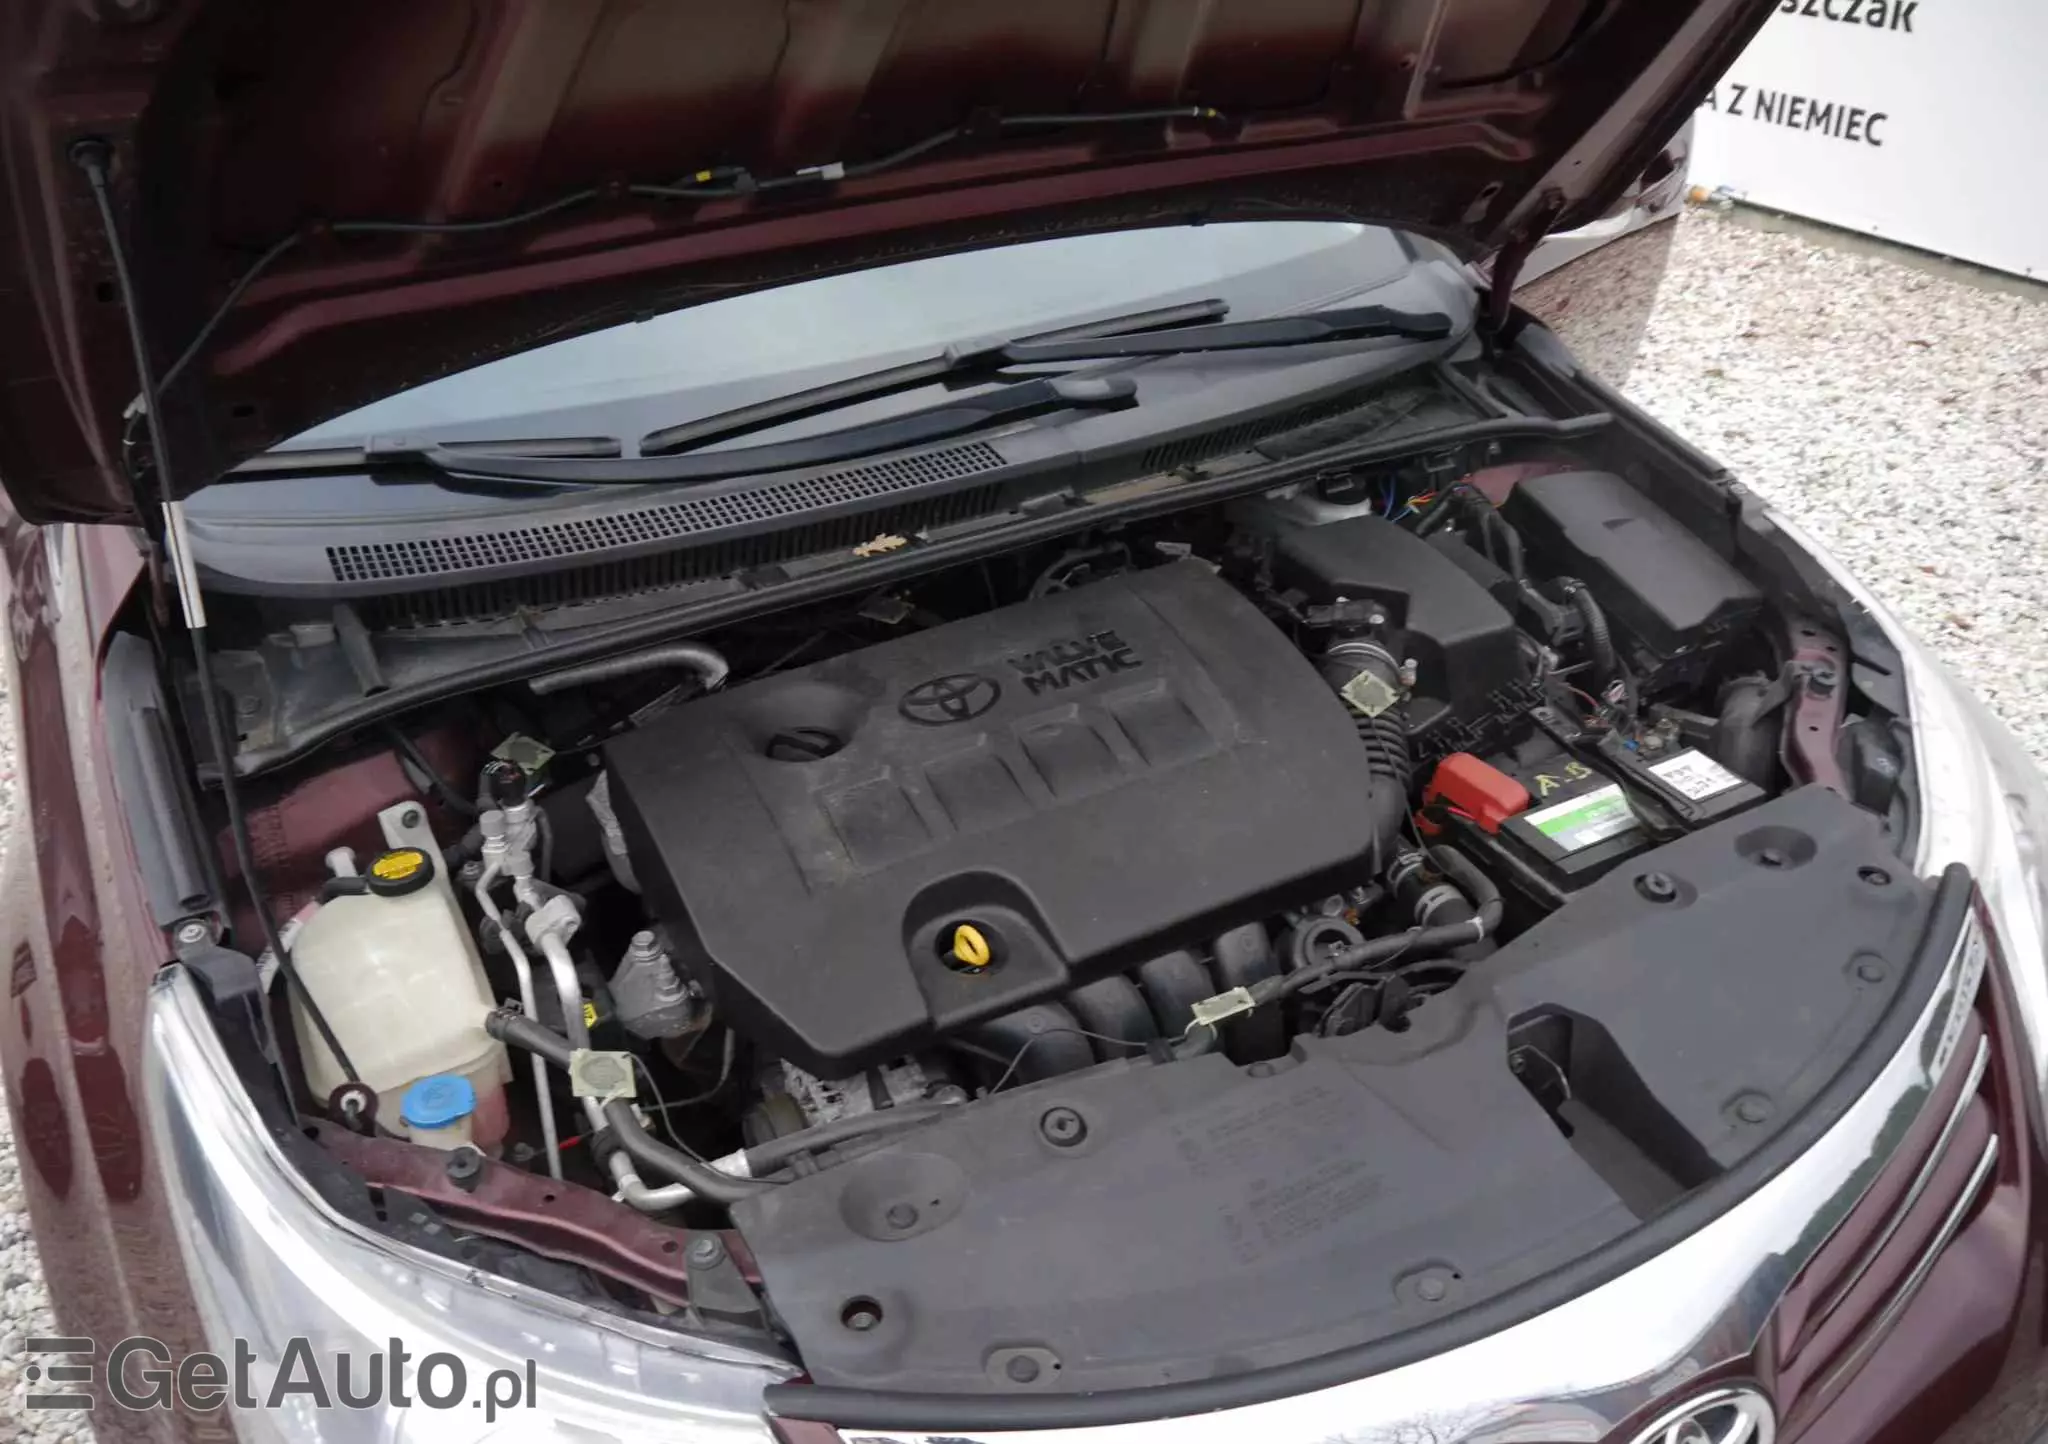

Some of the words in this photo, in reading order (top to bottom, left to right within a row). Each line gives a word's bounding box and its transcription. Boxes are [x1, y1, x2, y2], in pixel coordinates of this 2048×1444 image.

[1726, 82, 1748, 116] Z
[1753, 88, 1889, 147] NIEMIEC
[1021, 648, 1143, 697] MATIC
